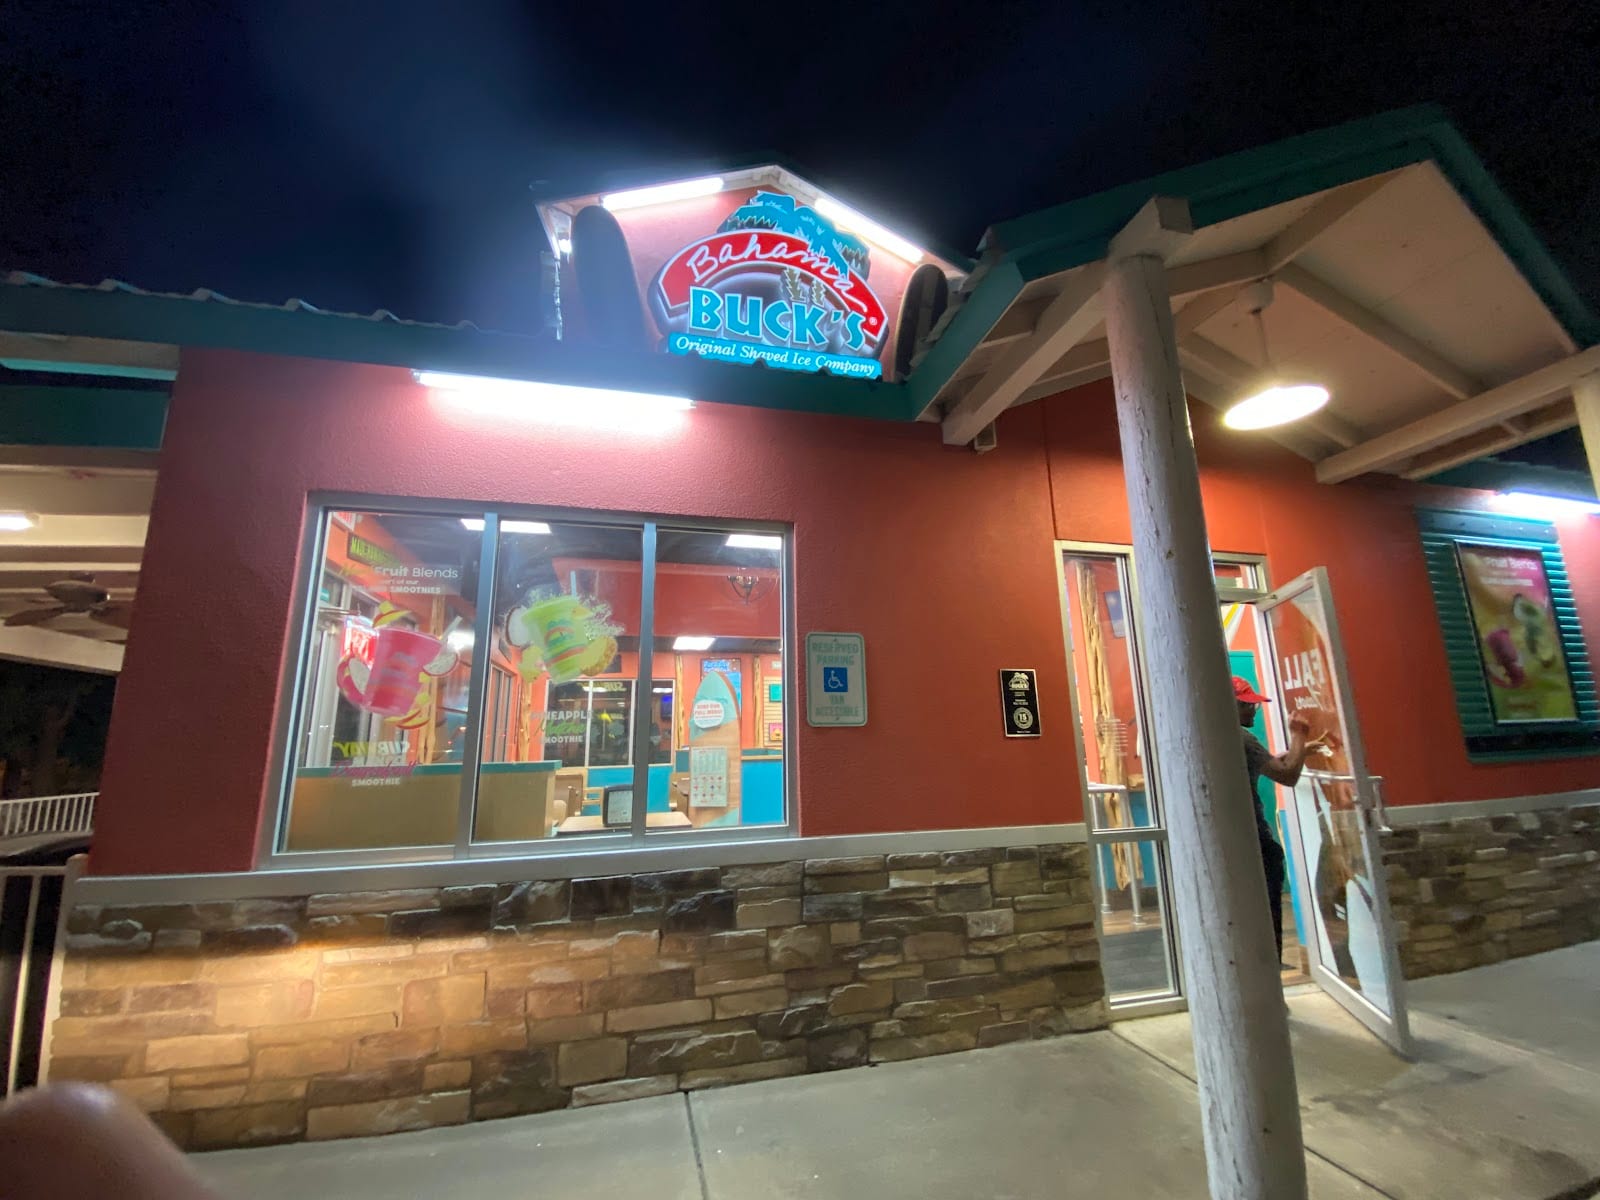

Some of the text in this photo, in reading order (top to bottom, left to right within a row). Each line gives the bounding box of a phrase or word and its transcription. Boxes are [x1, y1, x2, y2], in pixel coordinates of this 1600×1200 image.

[686, 233, 868, 313] Bahama
[690, 286, 866, 351] BUCK'S
[676, 336, 875, 377] Original Shaved Ice Company
[412, 567, 459, 578] Blends
[352, 777, 401, 788] SMOOTHIE
